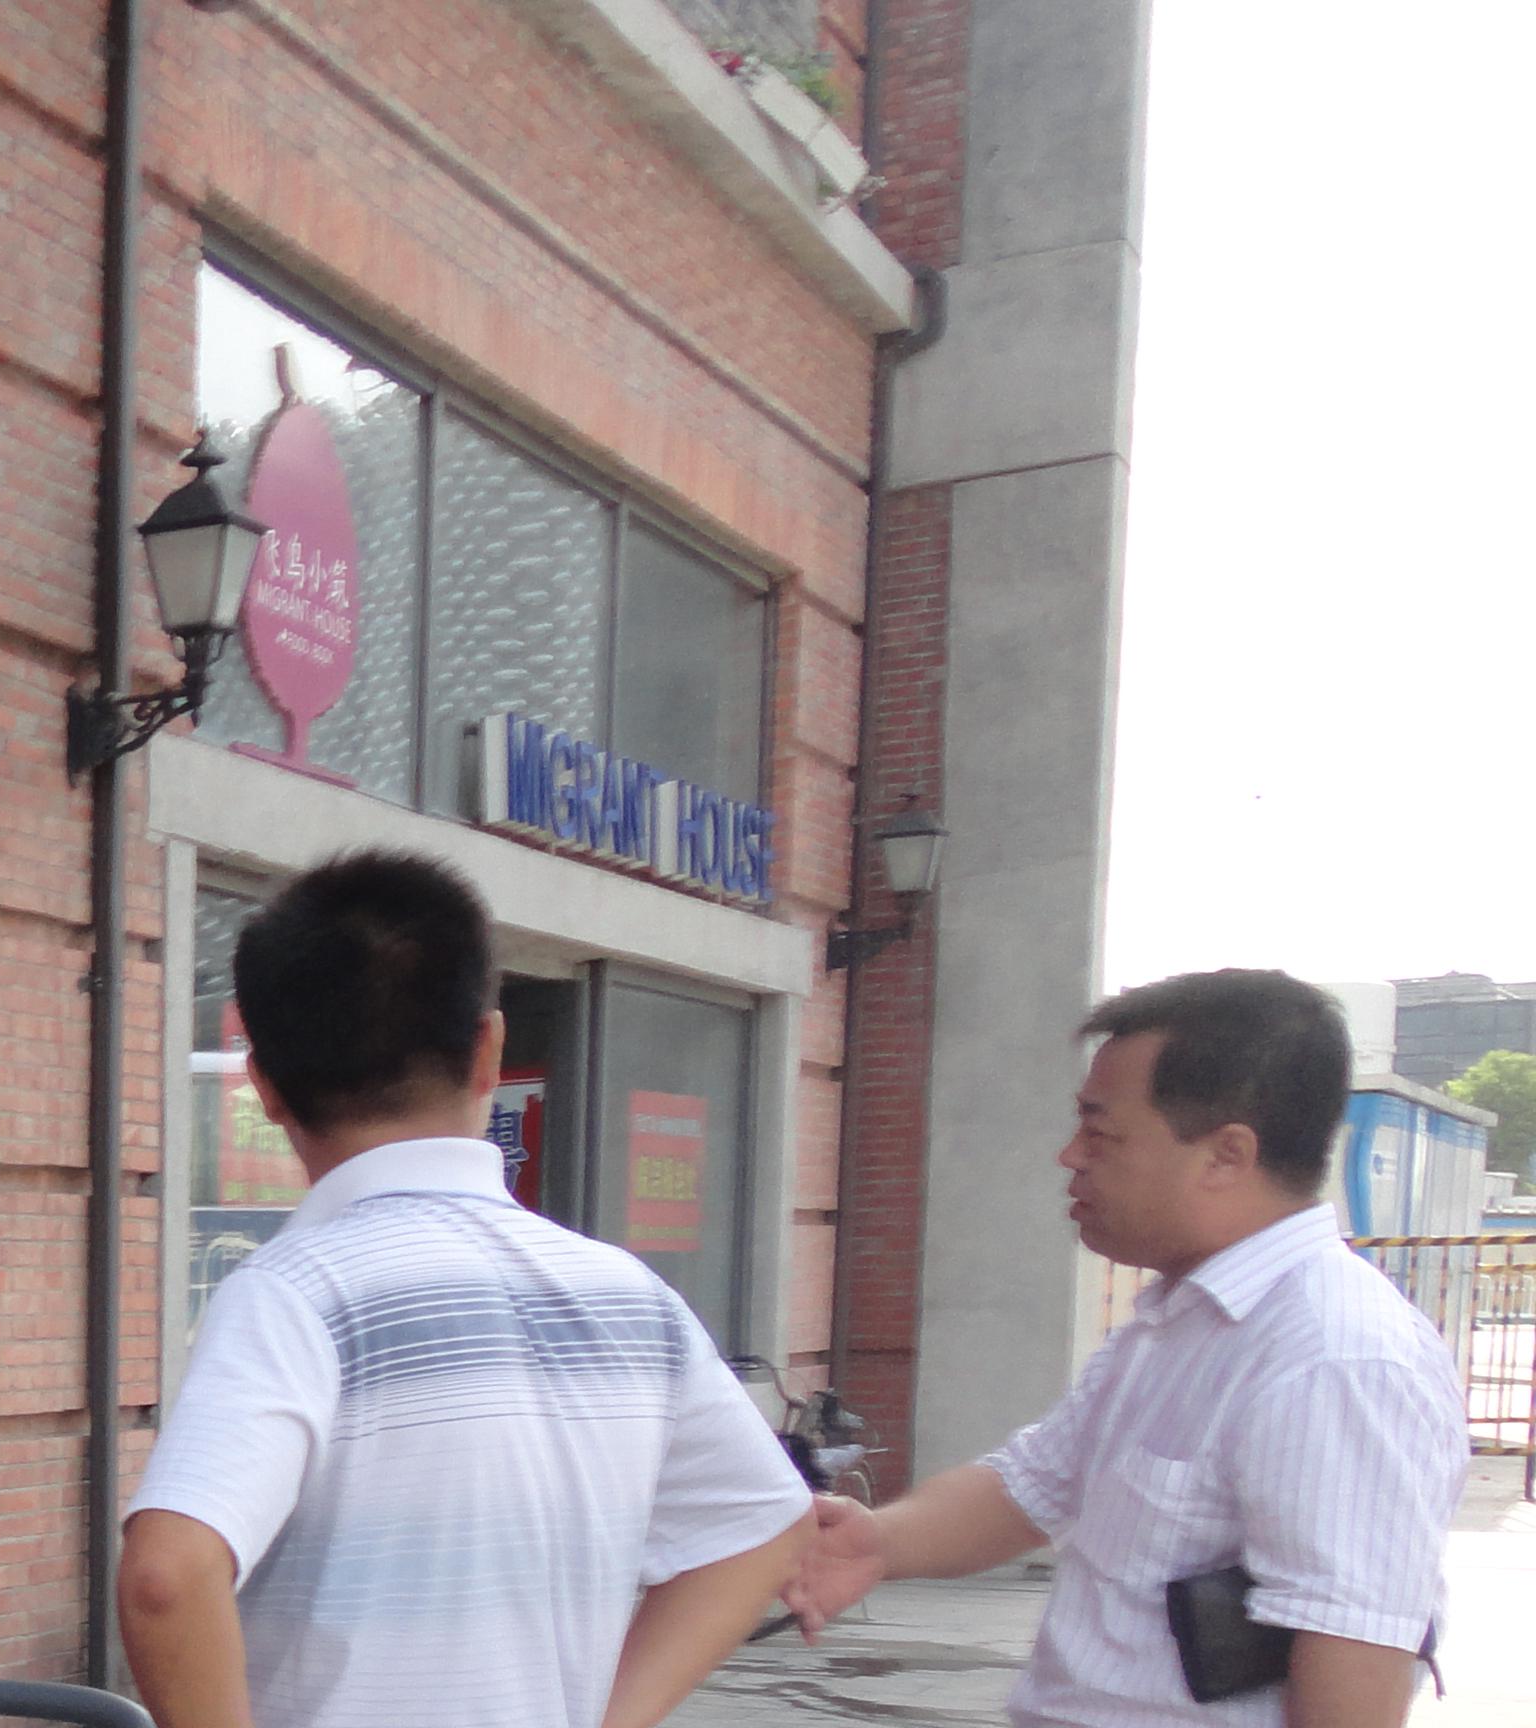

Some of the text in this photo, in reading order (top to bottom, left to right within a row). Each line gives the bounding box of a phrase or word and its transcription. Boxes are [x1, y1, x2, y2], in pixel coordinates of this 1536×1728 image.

[256, 578, 352, 645] MIGRANT HOUSE
[501, 711, 775, 900] MIGRANT HOUSE
